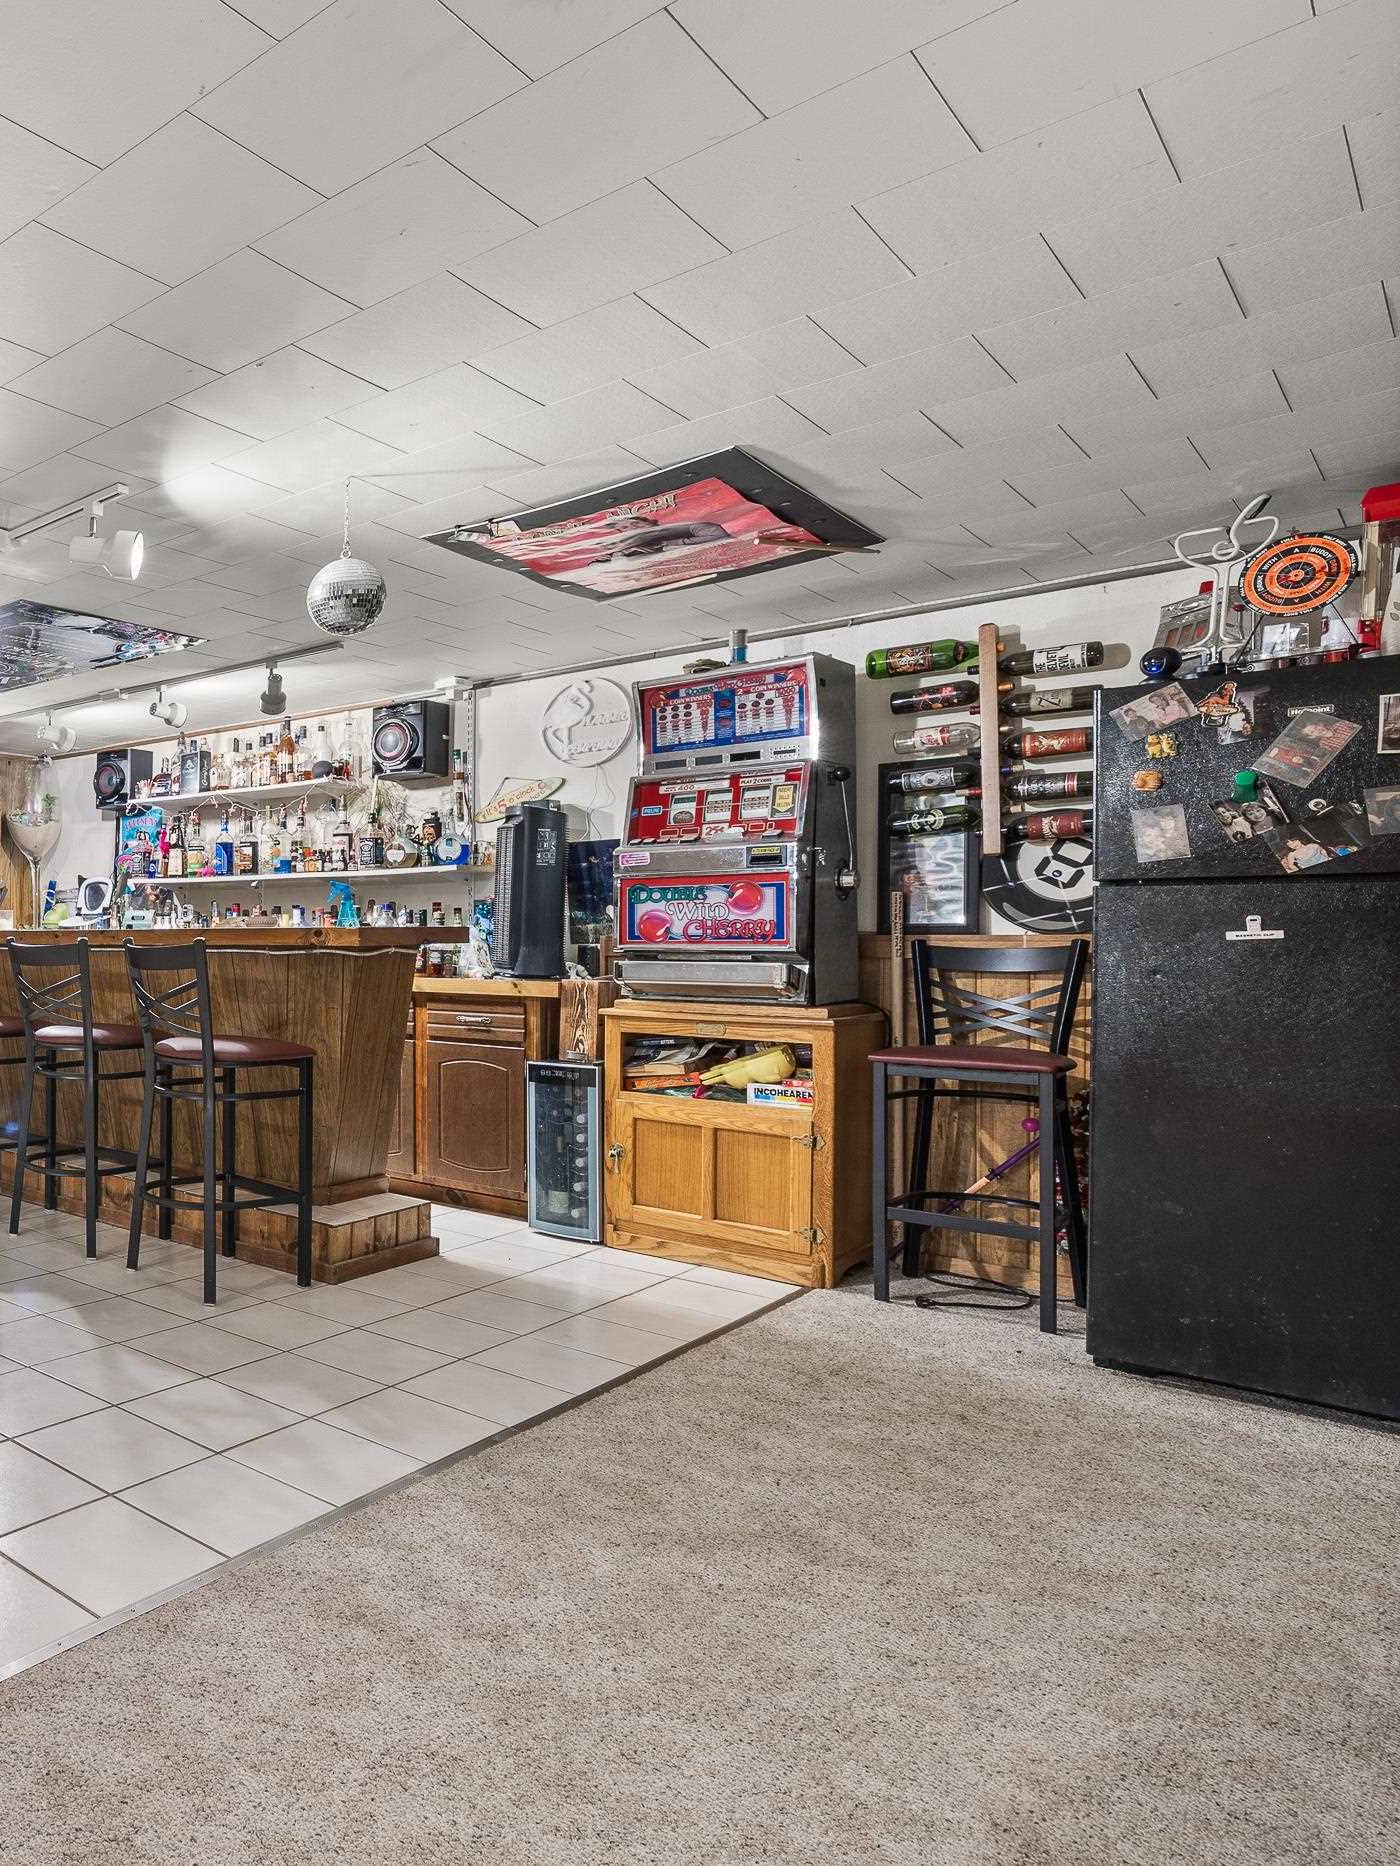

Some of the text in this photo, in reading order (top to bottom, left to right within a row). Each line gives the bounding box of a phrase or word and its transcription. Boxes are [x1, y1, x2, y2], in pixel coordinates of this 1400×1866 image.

[1310, 547, 1333, 559] BUDDY
[665, 901, 730, 921] WILD
[683, 919, 777, 943] CHERRY
